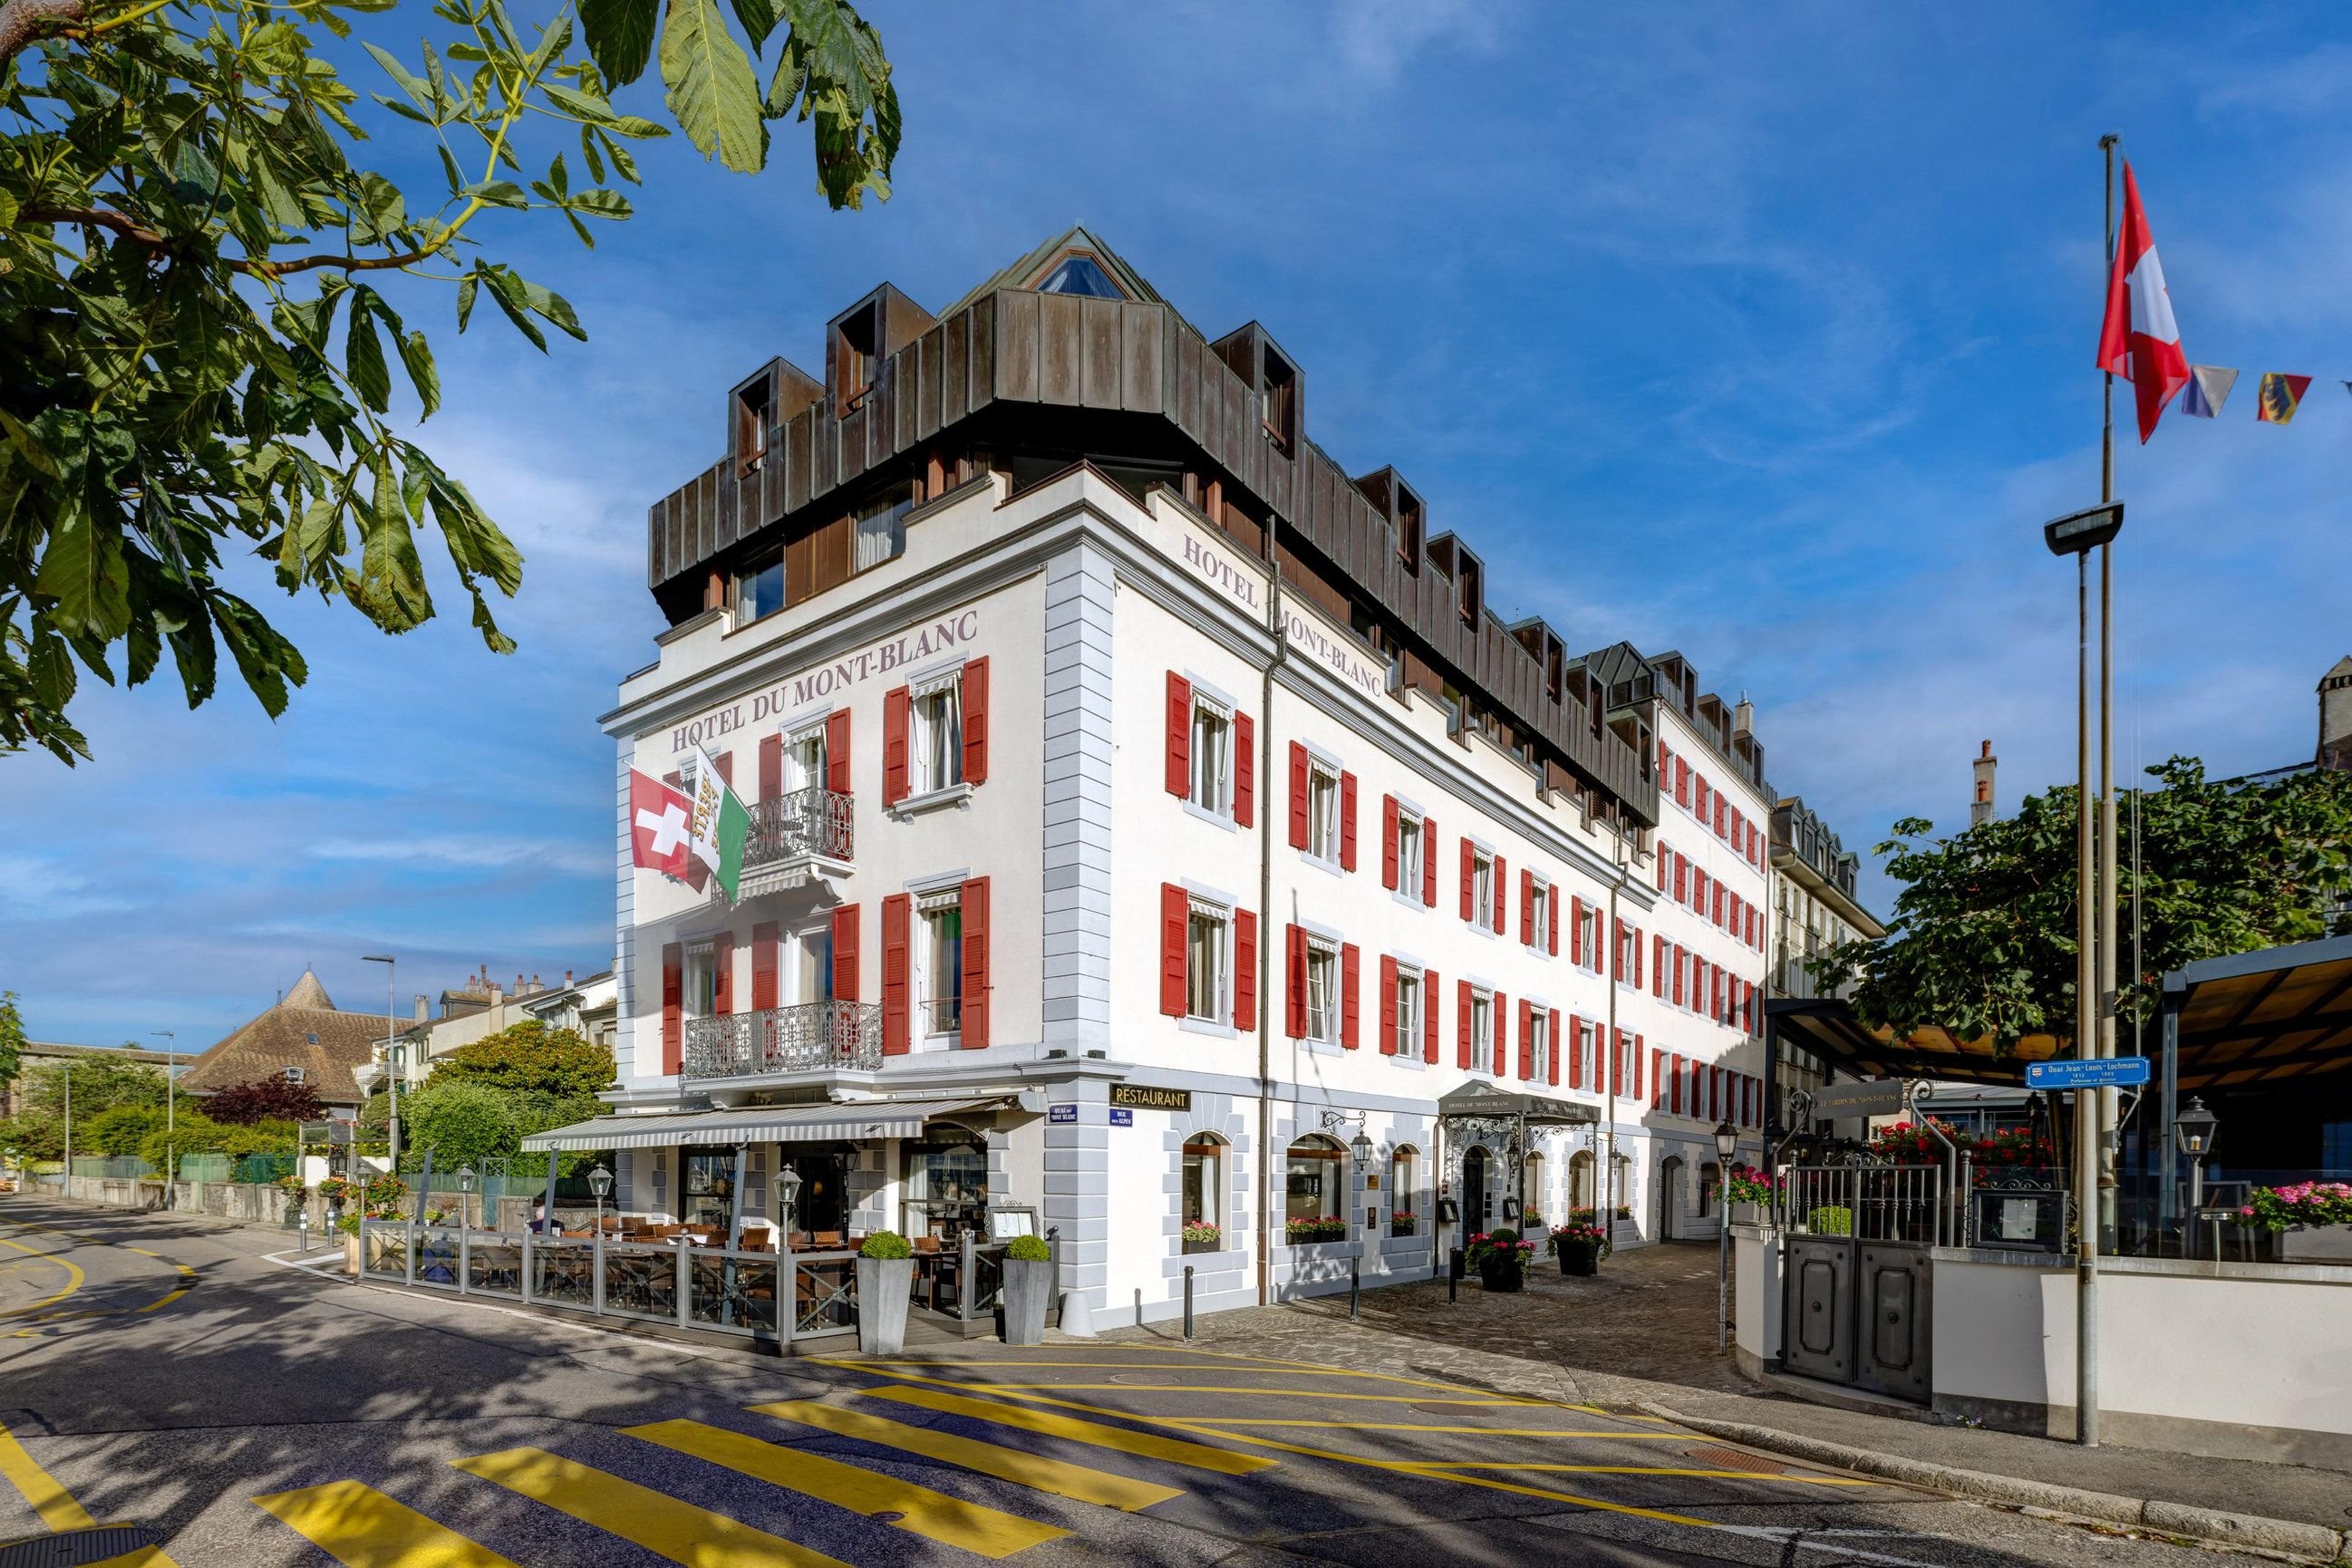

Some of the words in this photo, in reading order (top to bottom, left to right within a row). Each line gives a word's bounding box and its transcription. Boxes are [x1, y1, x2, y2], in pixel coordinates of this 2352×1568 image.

[1184, 533, 1257, 609] HOTEL
[672, 705, 746, 754] HOTEL
[752, 686, 788, 723] DU
[793, 610, 978, 707] MONT-BLANC
[1116, 1088, 1186, 1107] RESTAURANT
